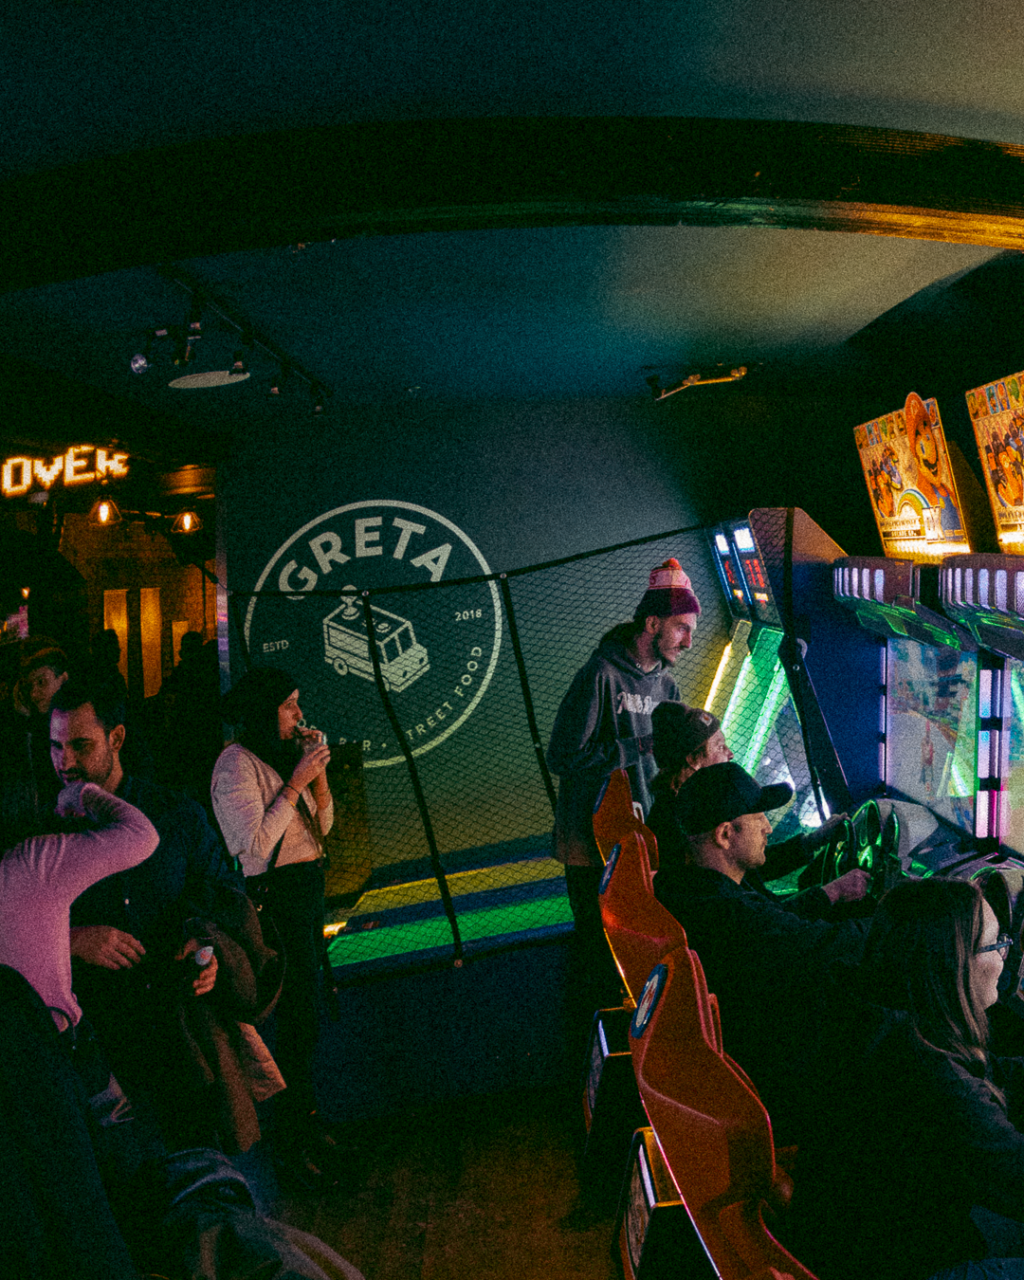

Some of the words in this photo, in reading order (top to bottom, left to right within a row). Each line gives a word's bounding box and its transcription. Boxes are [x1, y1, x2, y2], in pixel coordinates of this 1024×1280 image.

[278, 516, 453, 600] GRETA
[455, 609, 483, 621] 2018
[262, 640, 290, 653] ESTD
[402, 702, 454, 741] TREET
[454, 646, 483, 697] FOOD
